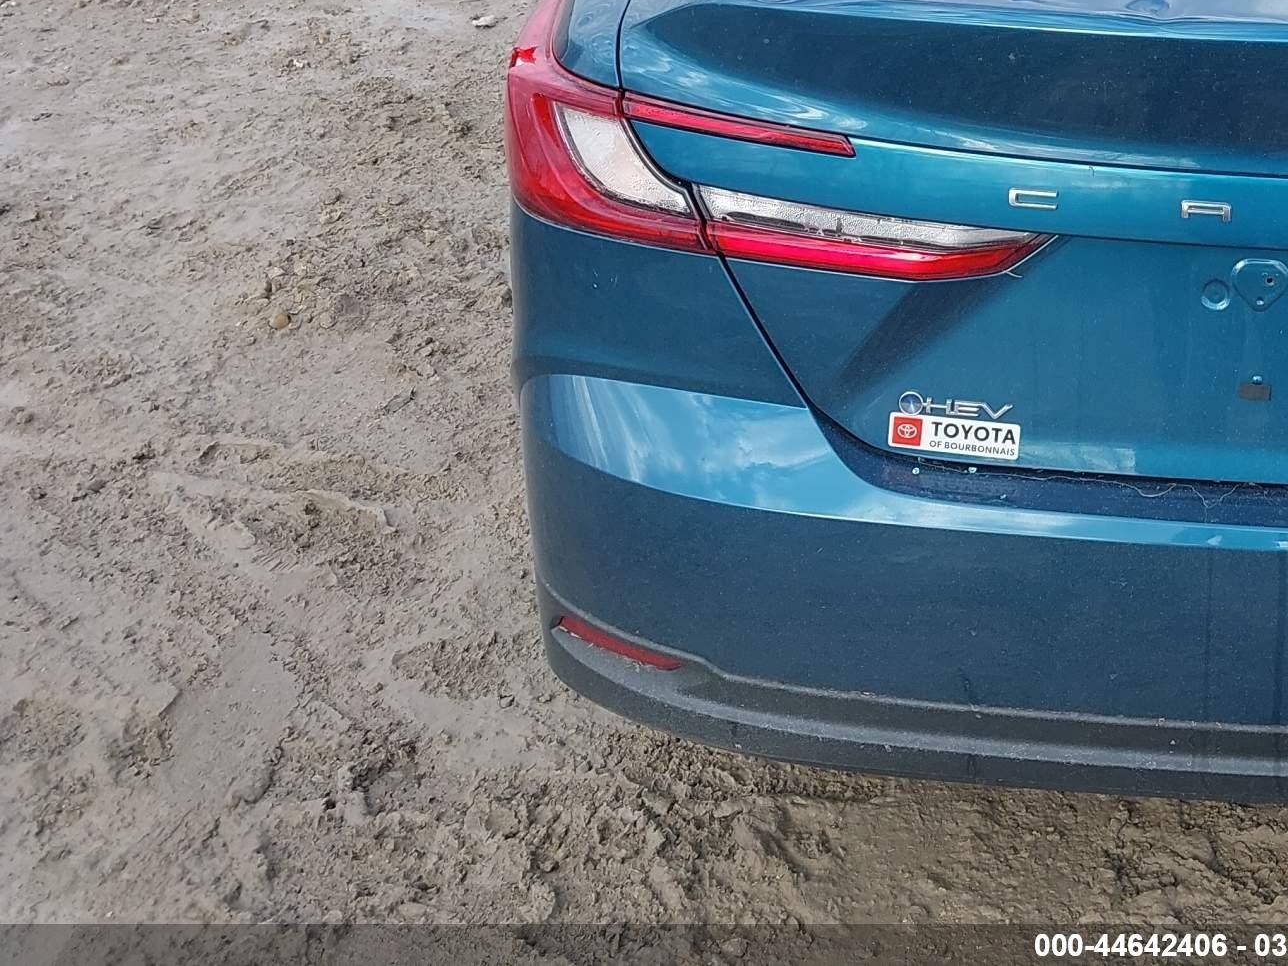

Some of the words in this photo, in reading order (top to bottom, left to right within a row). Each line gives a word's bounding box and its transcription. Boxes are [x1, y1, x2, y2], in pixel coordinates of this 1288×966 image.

[922, 397, 1013, 420] HEV
[931, 422, 1016, 444] TOYOTA
[929, 440, 942, 448] OF
[944, 441, 1015, 456] BOURBONNAIS
